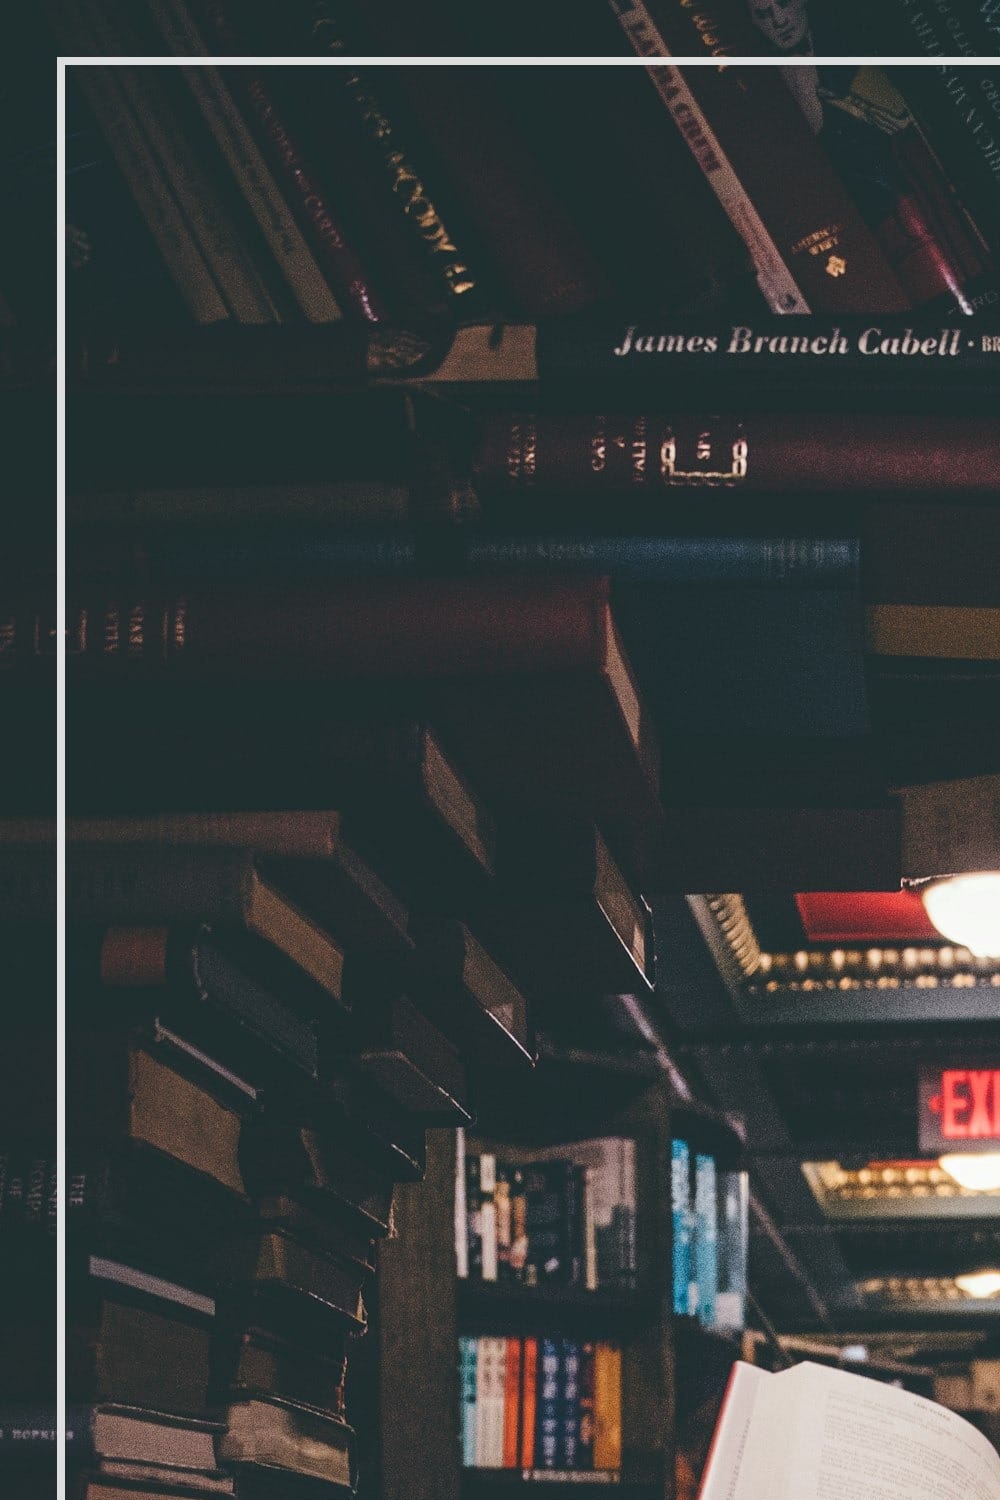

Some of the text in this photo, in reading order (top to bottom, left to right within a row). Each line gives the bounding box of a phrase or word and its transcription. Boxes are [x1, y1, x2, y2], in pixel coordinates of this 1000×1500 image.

[614, 327, 718, 356] James
[727, 327, 849, 355] Branch
[857, 328, 961, 356] Cabell
[12, 1428, 73, 1440] HOPKIS
